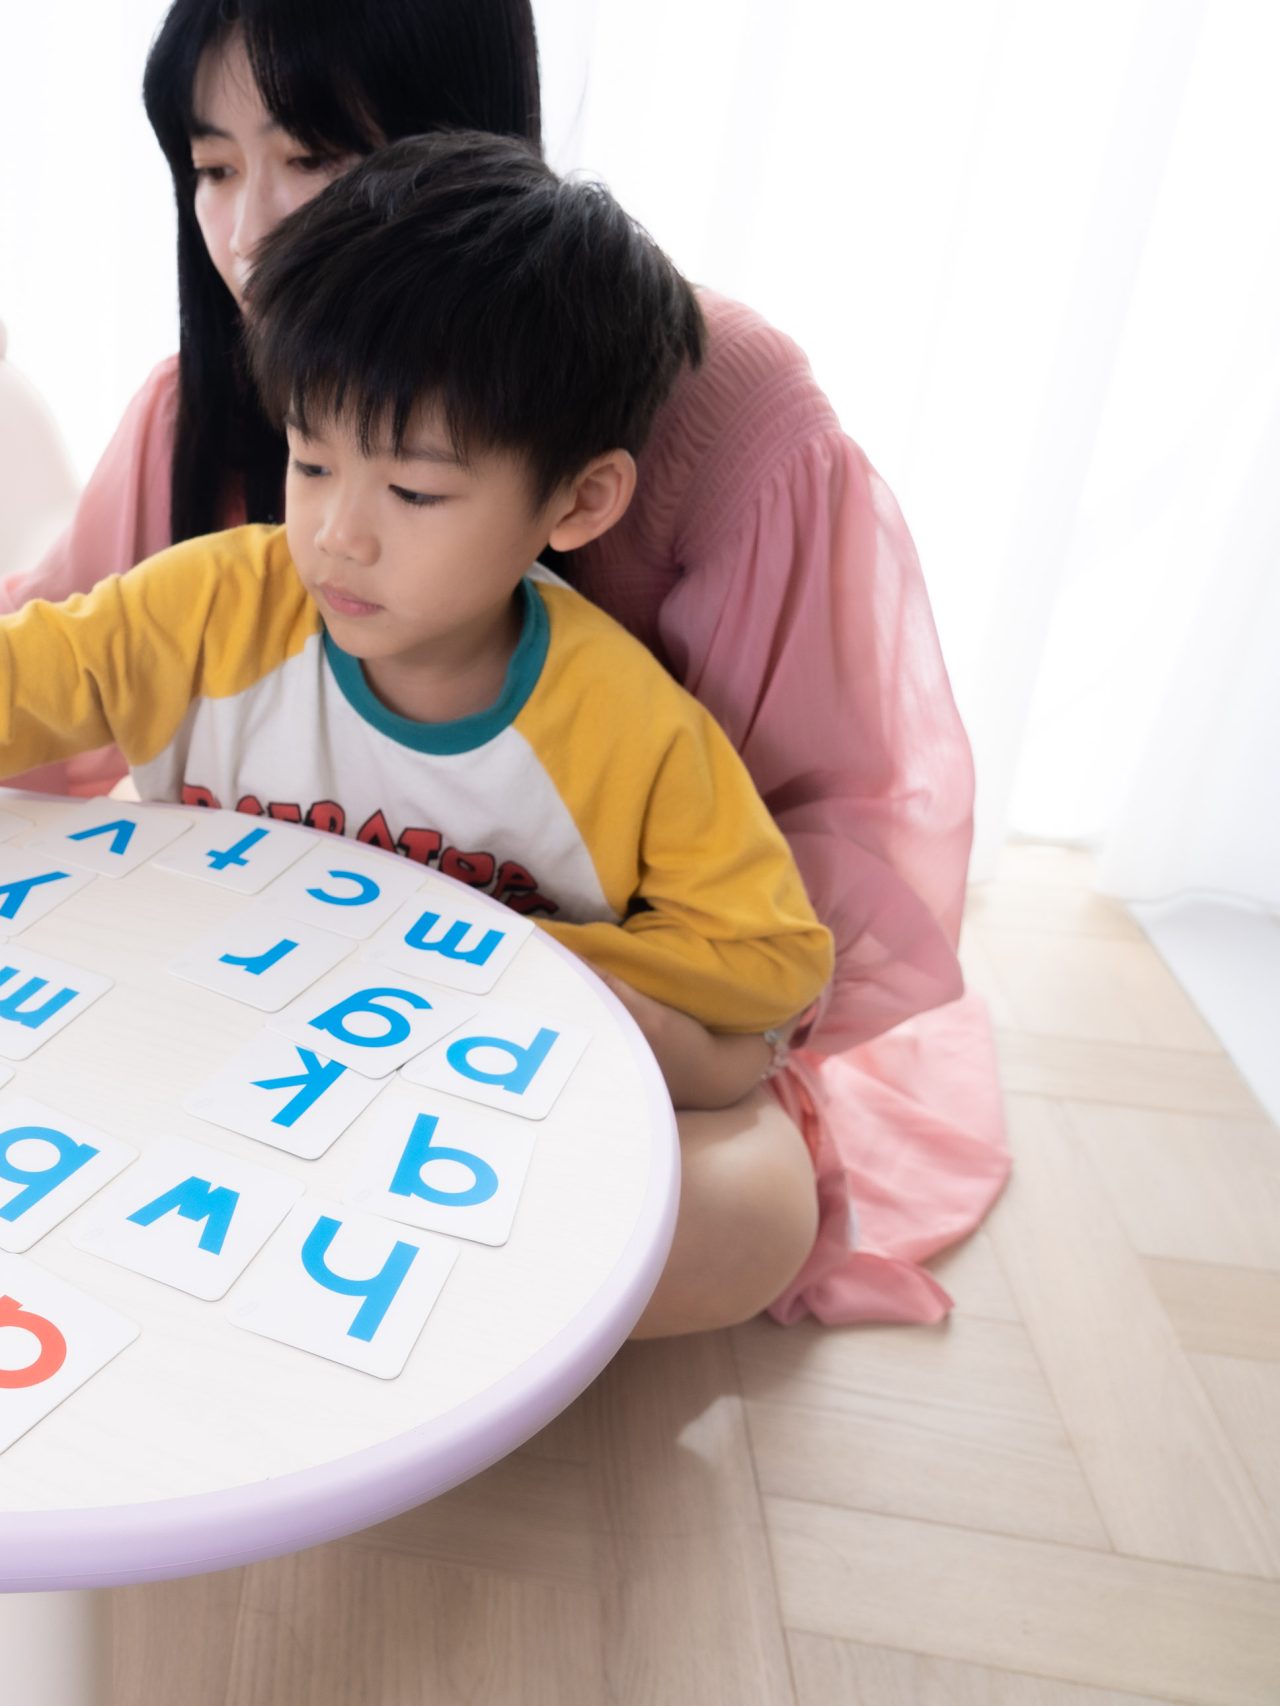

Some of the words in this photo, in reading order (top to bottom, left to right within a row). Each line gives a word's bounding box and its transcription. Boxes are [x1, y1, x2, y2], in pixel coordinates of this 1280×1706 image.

[67, 819, 137, 856] v
[207, 827, 270, 871] t
[306, 869, 381, 907] c
[218, 938, 299, 976] r
[307, 986, 433, 1049] g
[251, 1046, 348, 1128] k
[127, 1175, 240, 1255] w
[301, 1215, 419, 1342] h
